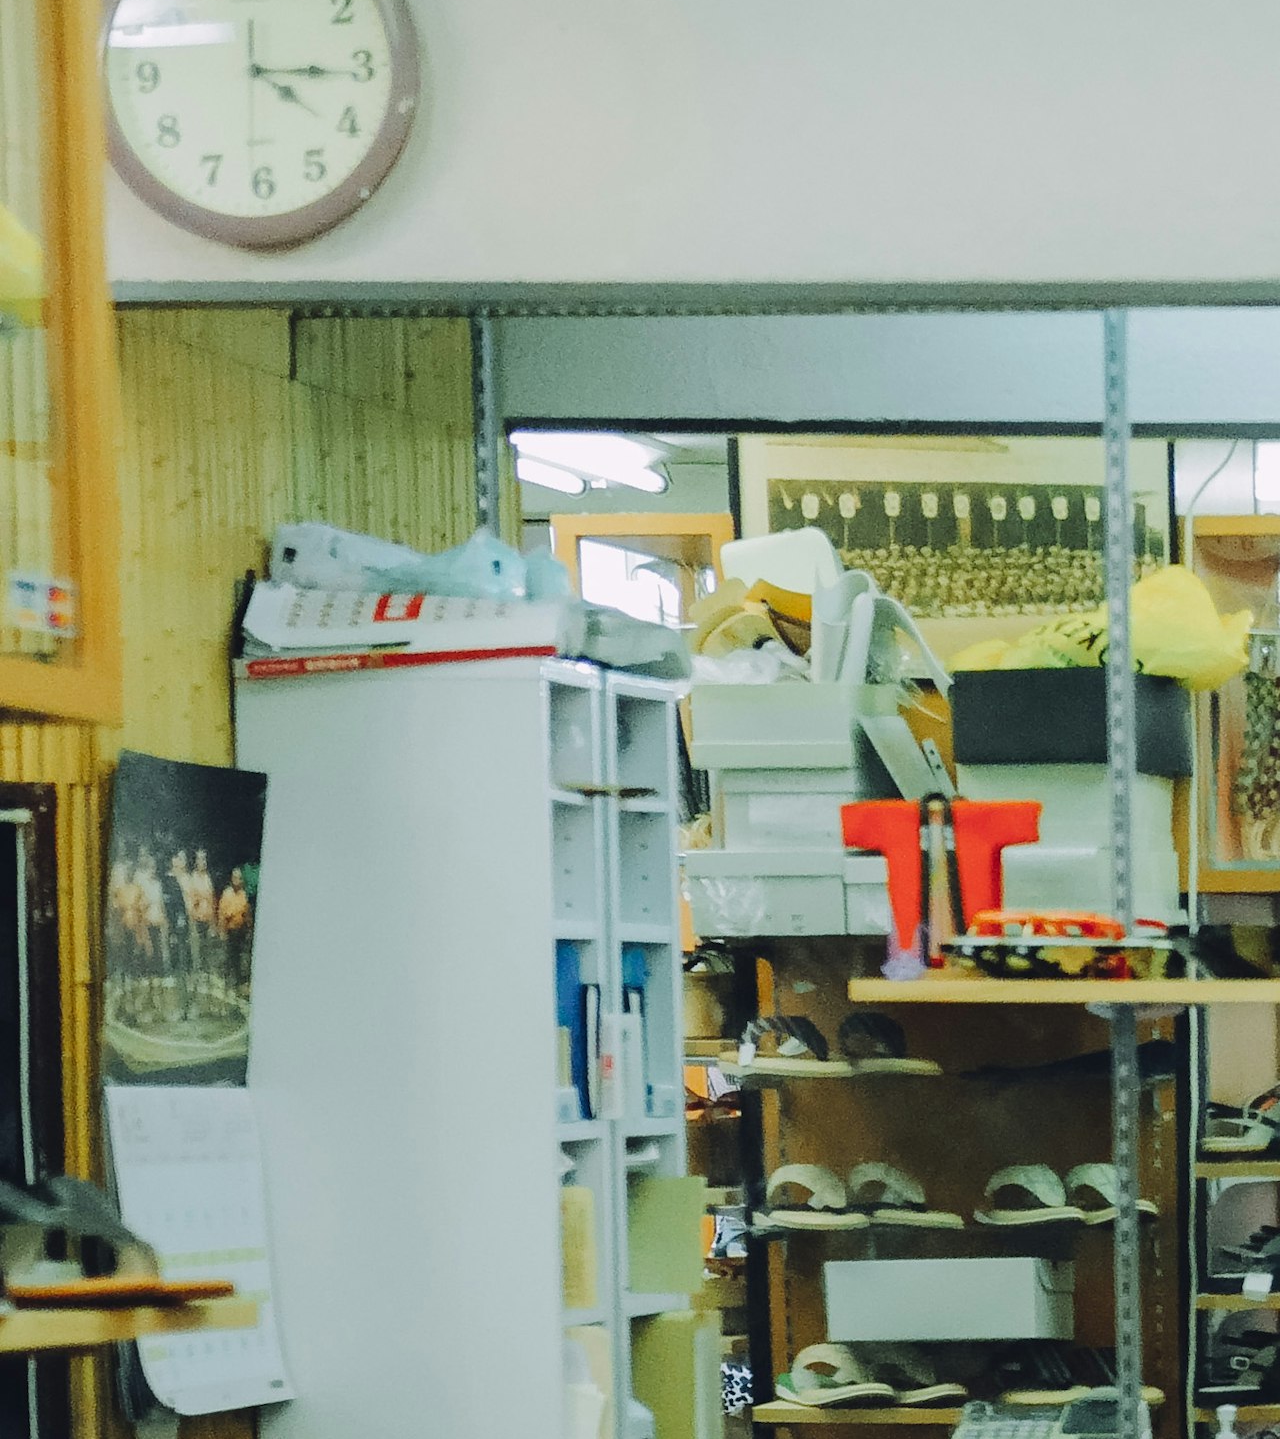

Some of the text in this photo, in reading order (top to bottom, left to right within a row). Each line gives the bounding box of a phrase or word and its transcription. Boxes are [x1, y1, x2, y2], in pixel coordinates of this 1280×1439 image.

[136, 60, 161, 94] 9
[351, 49, 375, 83] 3
[157, 114, 181, 149] 8
[336, 106, 361, 138] 4
[201, 153, 223, 186] 7
[303, 148, 328, 182] 5
[251, 166, 277, 200] 6
